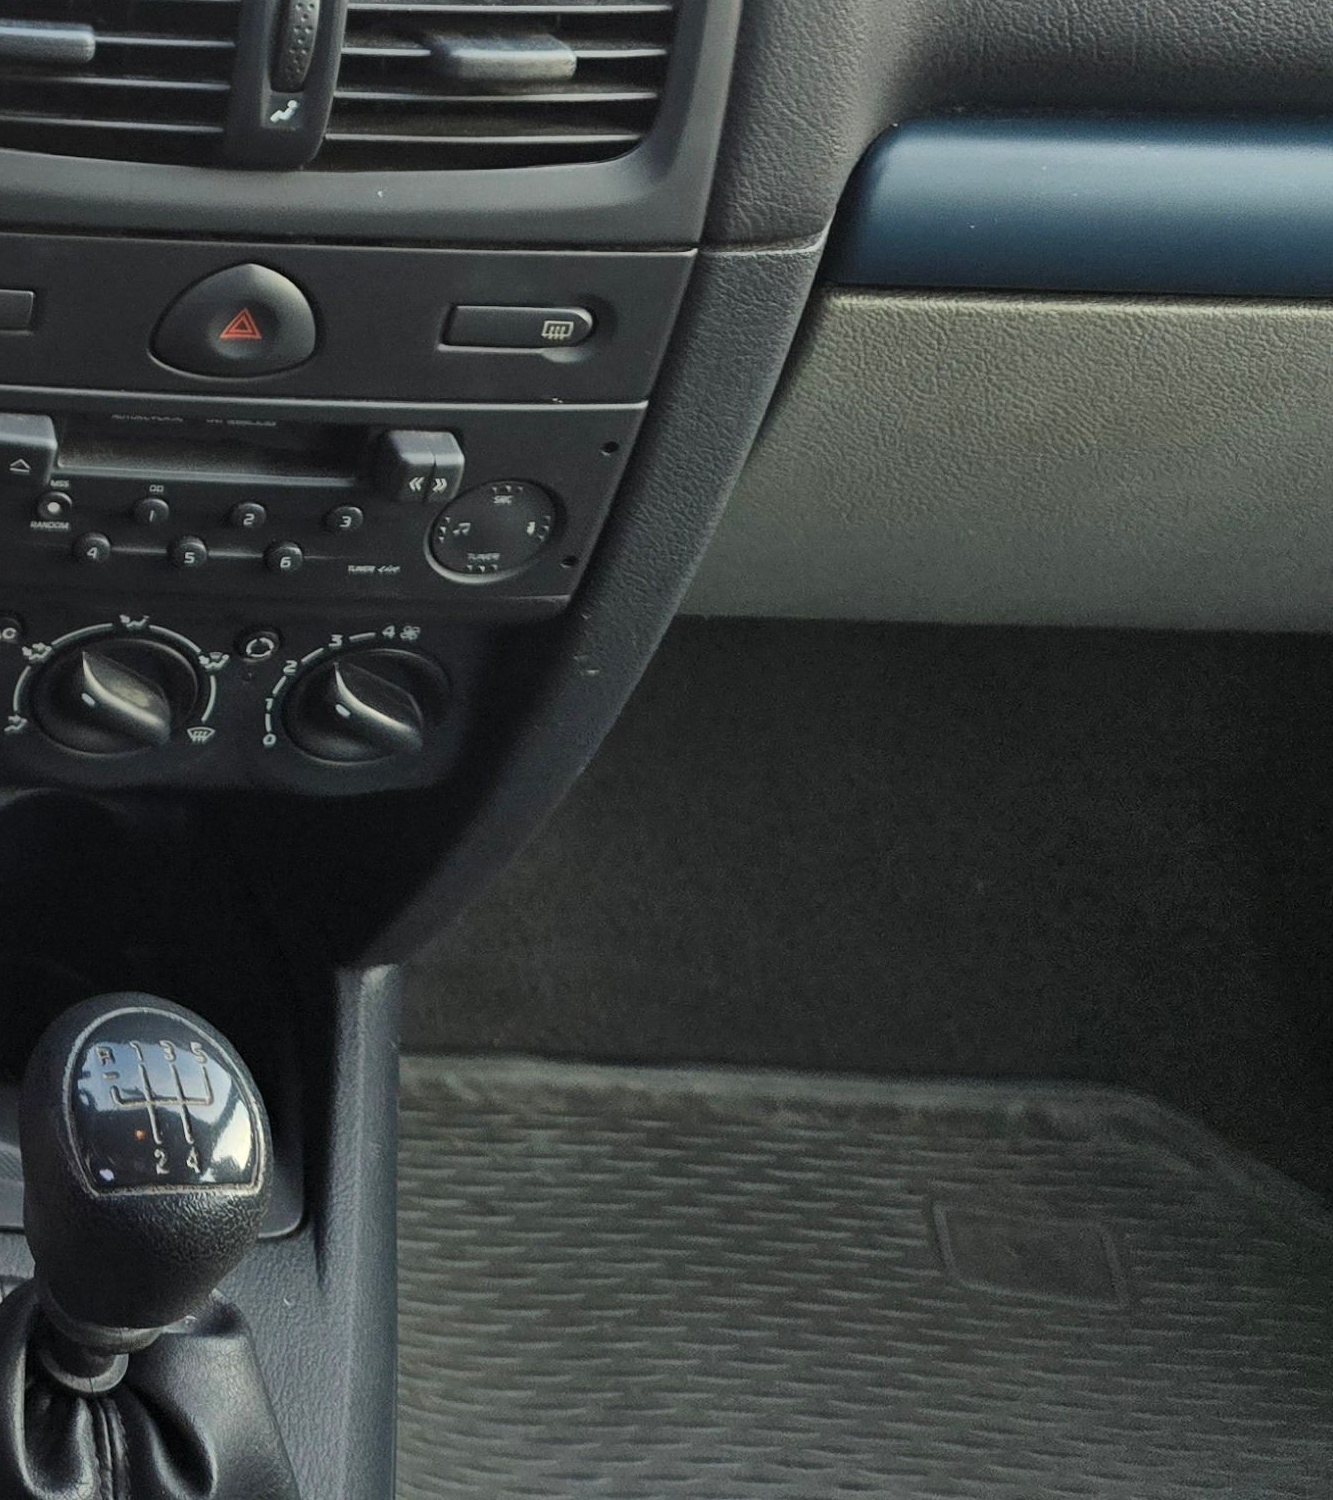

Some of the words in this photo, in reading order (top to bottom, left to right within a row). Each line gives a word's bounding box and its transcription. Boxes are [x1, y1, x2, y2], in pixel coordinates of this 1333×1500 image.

[148, 509, 155, 523] 1
[243, 513, 255, 526] 2
[339, 516, 352, 528] 3
[30, 521, 70, 531] RANDOM
[86, 547, 98, 559] 4
[184, 552, 195, 564] 5
[280, 556, 292, 569] 6
[382, 625, 396, 638] 4
[329, 634, 343, 648] 3
[283, 660, 298, 675] 2
[265, 698, 274, 711] 1
[263, 733, 277, 747] 0
[130, 1040, 144, 1062] 1
[159, 1040, 178, 1062] 3
[190, 1041, 209, 1065] 5
[154, 1148, 171, 1175] 2
[186, 1150, 202, 1174] 4
